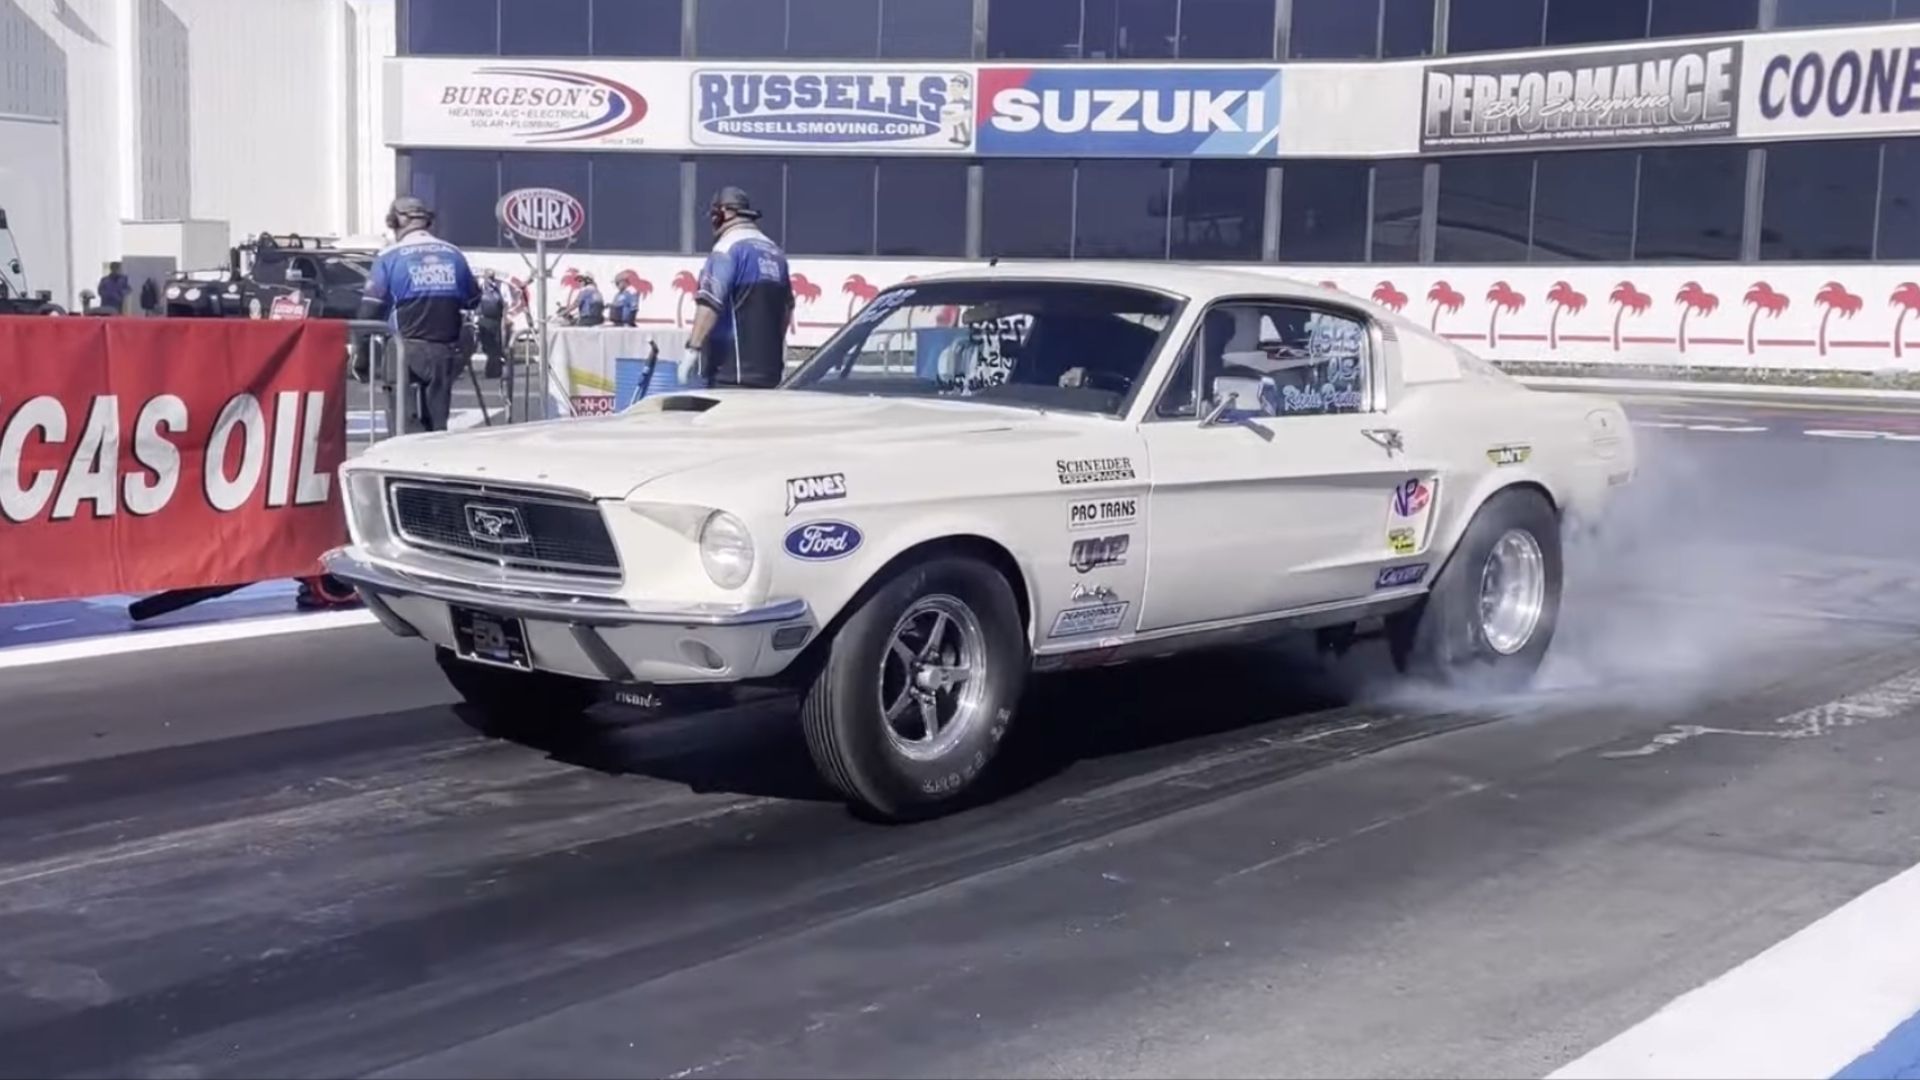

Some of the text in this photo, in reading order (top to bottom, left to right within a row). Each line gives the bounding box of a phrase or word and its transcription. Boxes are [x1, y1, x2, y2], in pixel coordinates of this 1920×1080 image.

[440, 87, 605, 107] BURGESON'S
[1425, 47, 1733, 136] PERFORMANCE
[1759, 48, 1920, 120] COONE
[699, 74, 947, 124] RUSSELLS
[991, 88, 1265, 134] SUZUKI
[1483, 102, 1530, 120] Bob
[449, 108, 493, 118] HEATING
[527, 109, 590, 120] ELECTRICAL
[471, 119, 560, 129] SOLAR PLUMBING
[718, 121, 926, 135] RUSSELLSMOVING.COM
[518, 197, 572, 230] NHRA
[411, 273, 456, 286] WORLD
[0, 390, 332, 523] CAS OIL
[1056, 458, 1132, 473] SCHNEIDER
[785, 473, 847, 516] JONES
[1396, 478, 1419, 517] VP
[1071, 500, 1136, 521] PRO TRANS
[799, 525, 848, 553] Ford
